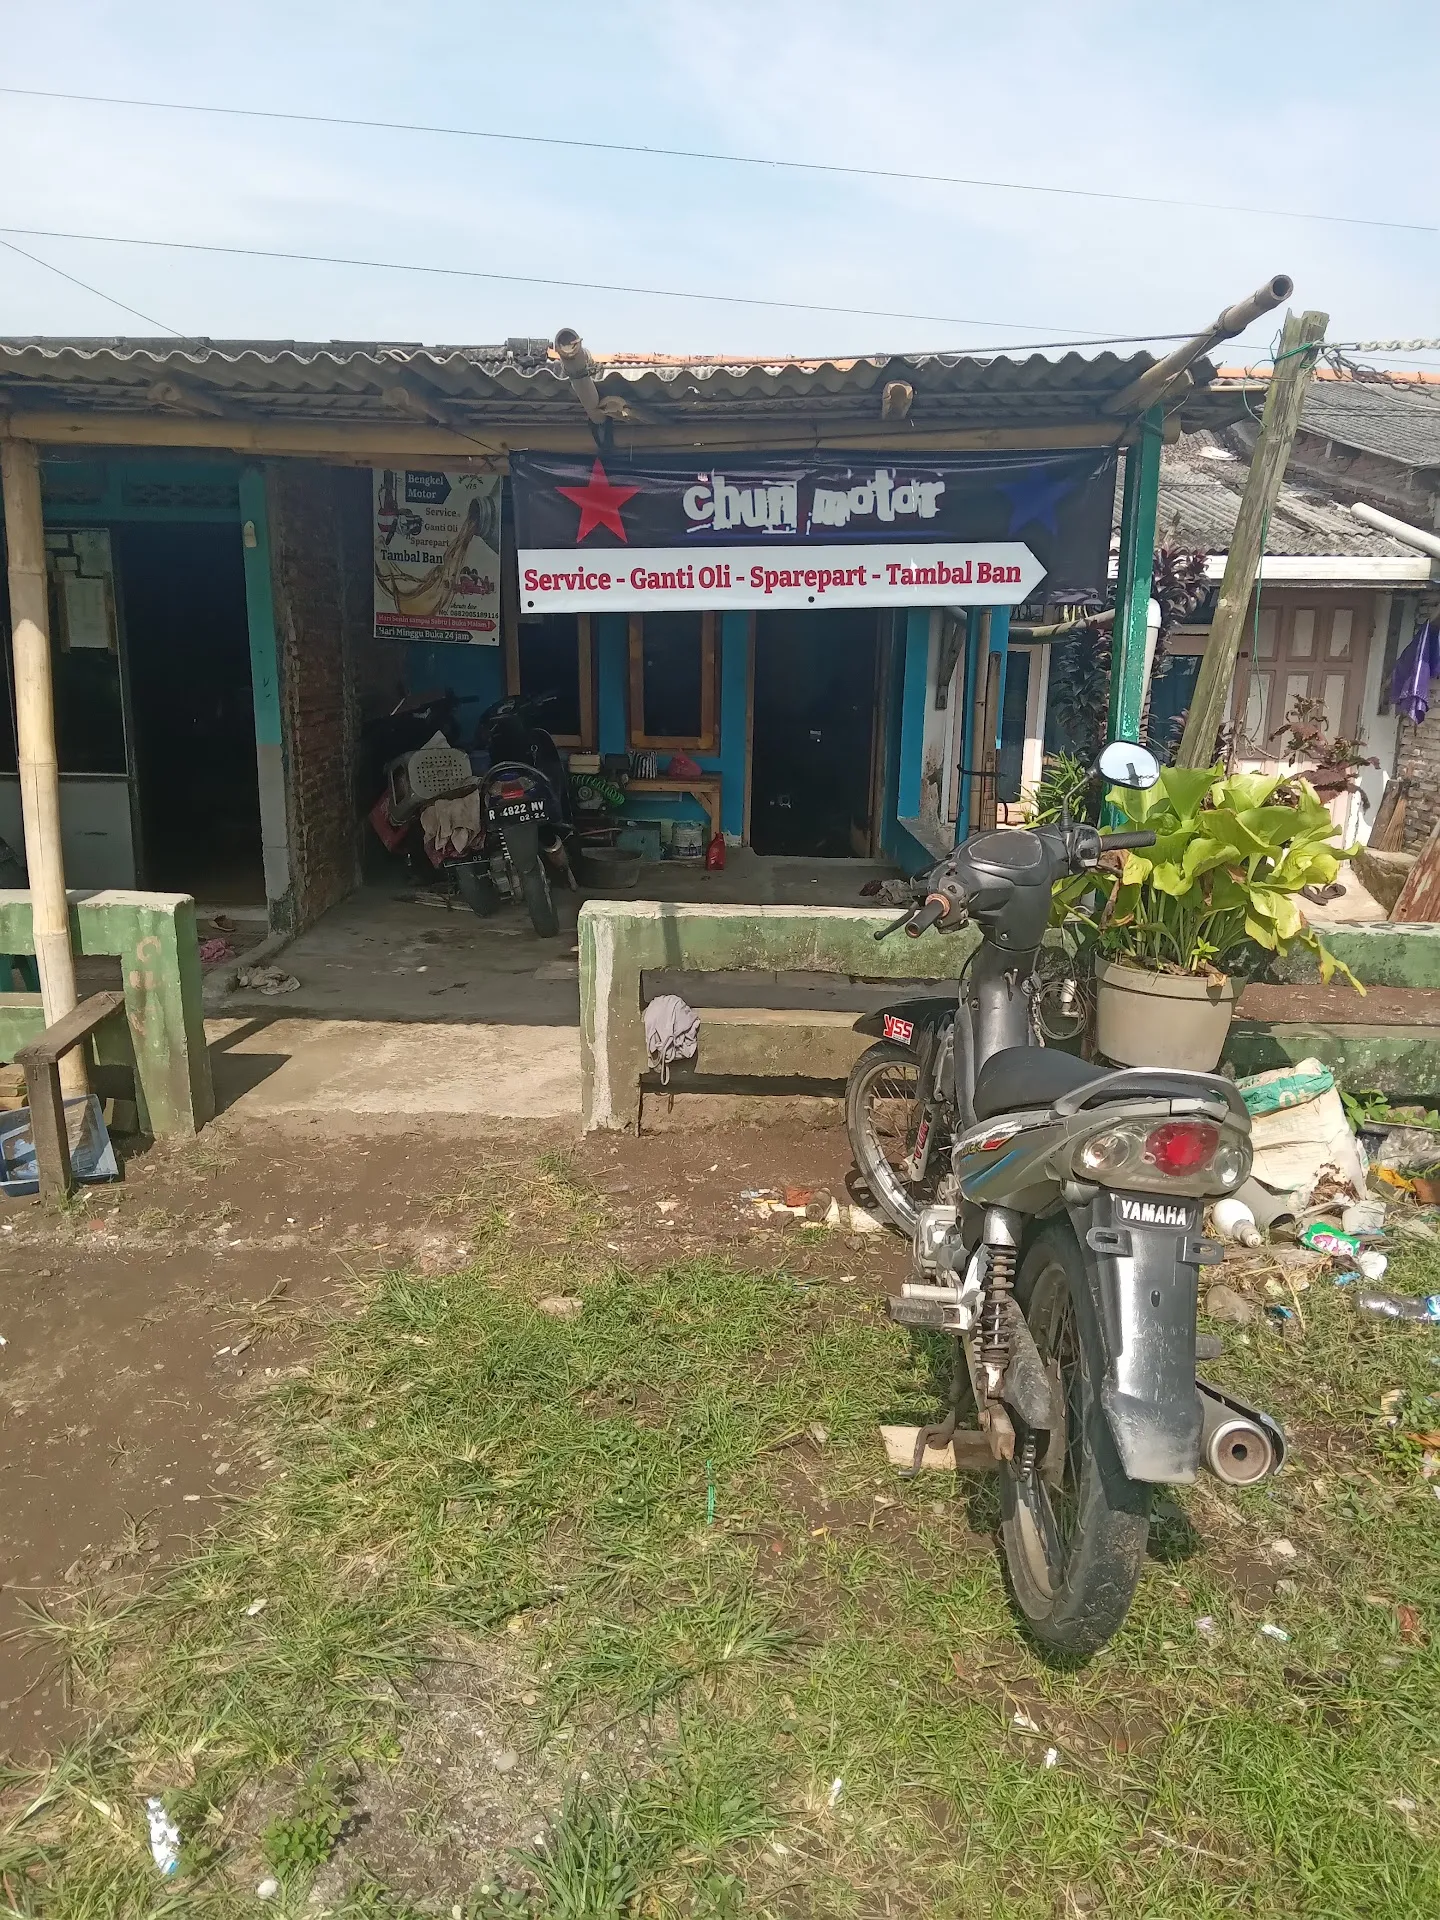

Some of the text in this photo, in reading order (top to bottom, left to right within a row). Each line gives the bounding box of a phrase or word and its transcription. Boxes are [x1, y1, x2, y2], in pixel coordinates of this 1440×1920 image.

[408, 474, 444, 486] Bengkel
[408, 488, 437, 499] Motor
[683, 469, 946, 535] chun motor
[425, 507, 457, 517] Service
[424, 523, 446, 532] Ganti
[410, 537, 449, 548] Sparepart
[380, 549, 443, 564] Tambal Ban
[524, 567, 612, 591] Service
[630, 565, 694, 590] Ganti
[699, 565, 731, 588] Oli
[750, 565, 867, 593] Sparepart
[886, 561, 972, 586] Tambal
[977, 562, 1022, 584] Ban
[378, 627, 470, 641] Hari Minggu Buka 24 jam
[488, 801, 544, 820] R 4822 MV
[1121, 1200, 1186, 1226] YAMAHA
